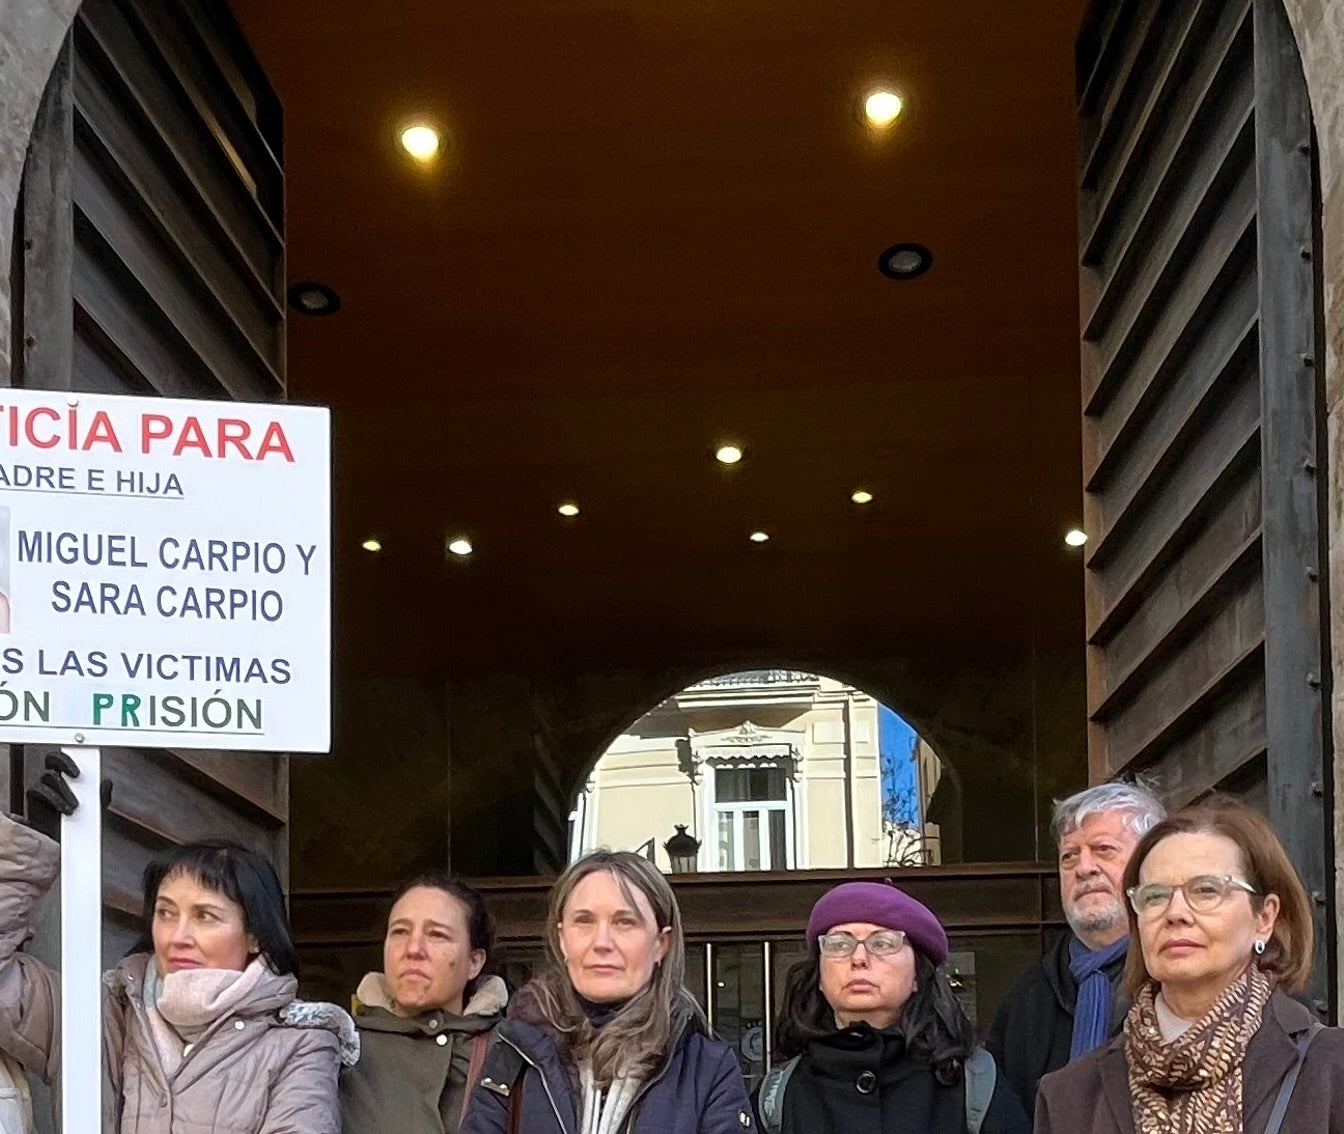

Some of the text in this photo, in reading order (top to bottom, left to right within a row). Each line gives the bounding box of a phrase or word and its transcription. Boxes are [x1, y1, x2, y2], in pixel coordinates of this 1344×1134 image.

[142, 412, 296, 463] PARA
[87, 468, 105, 491] E
[116, 471, 184, 496] HIJA
[18, 530, 317, 576] MIGUEL CARPIO Y
[51, 580, 283, 622] SARA CARPIO
[38, 649, 108, 678] LAS
[120, 652, 292, 685] VICTIMAS
[92, 688, 263, 730] PRISIÓN
